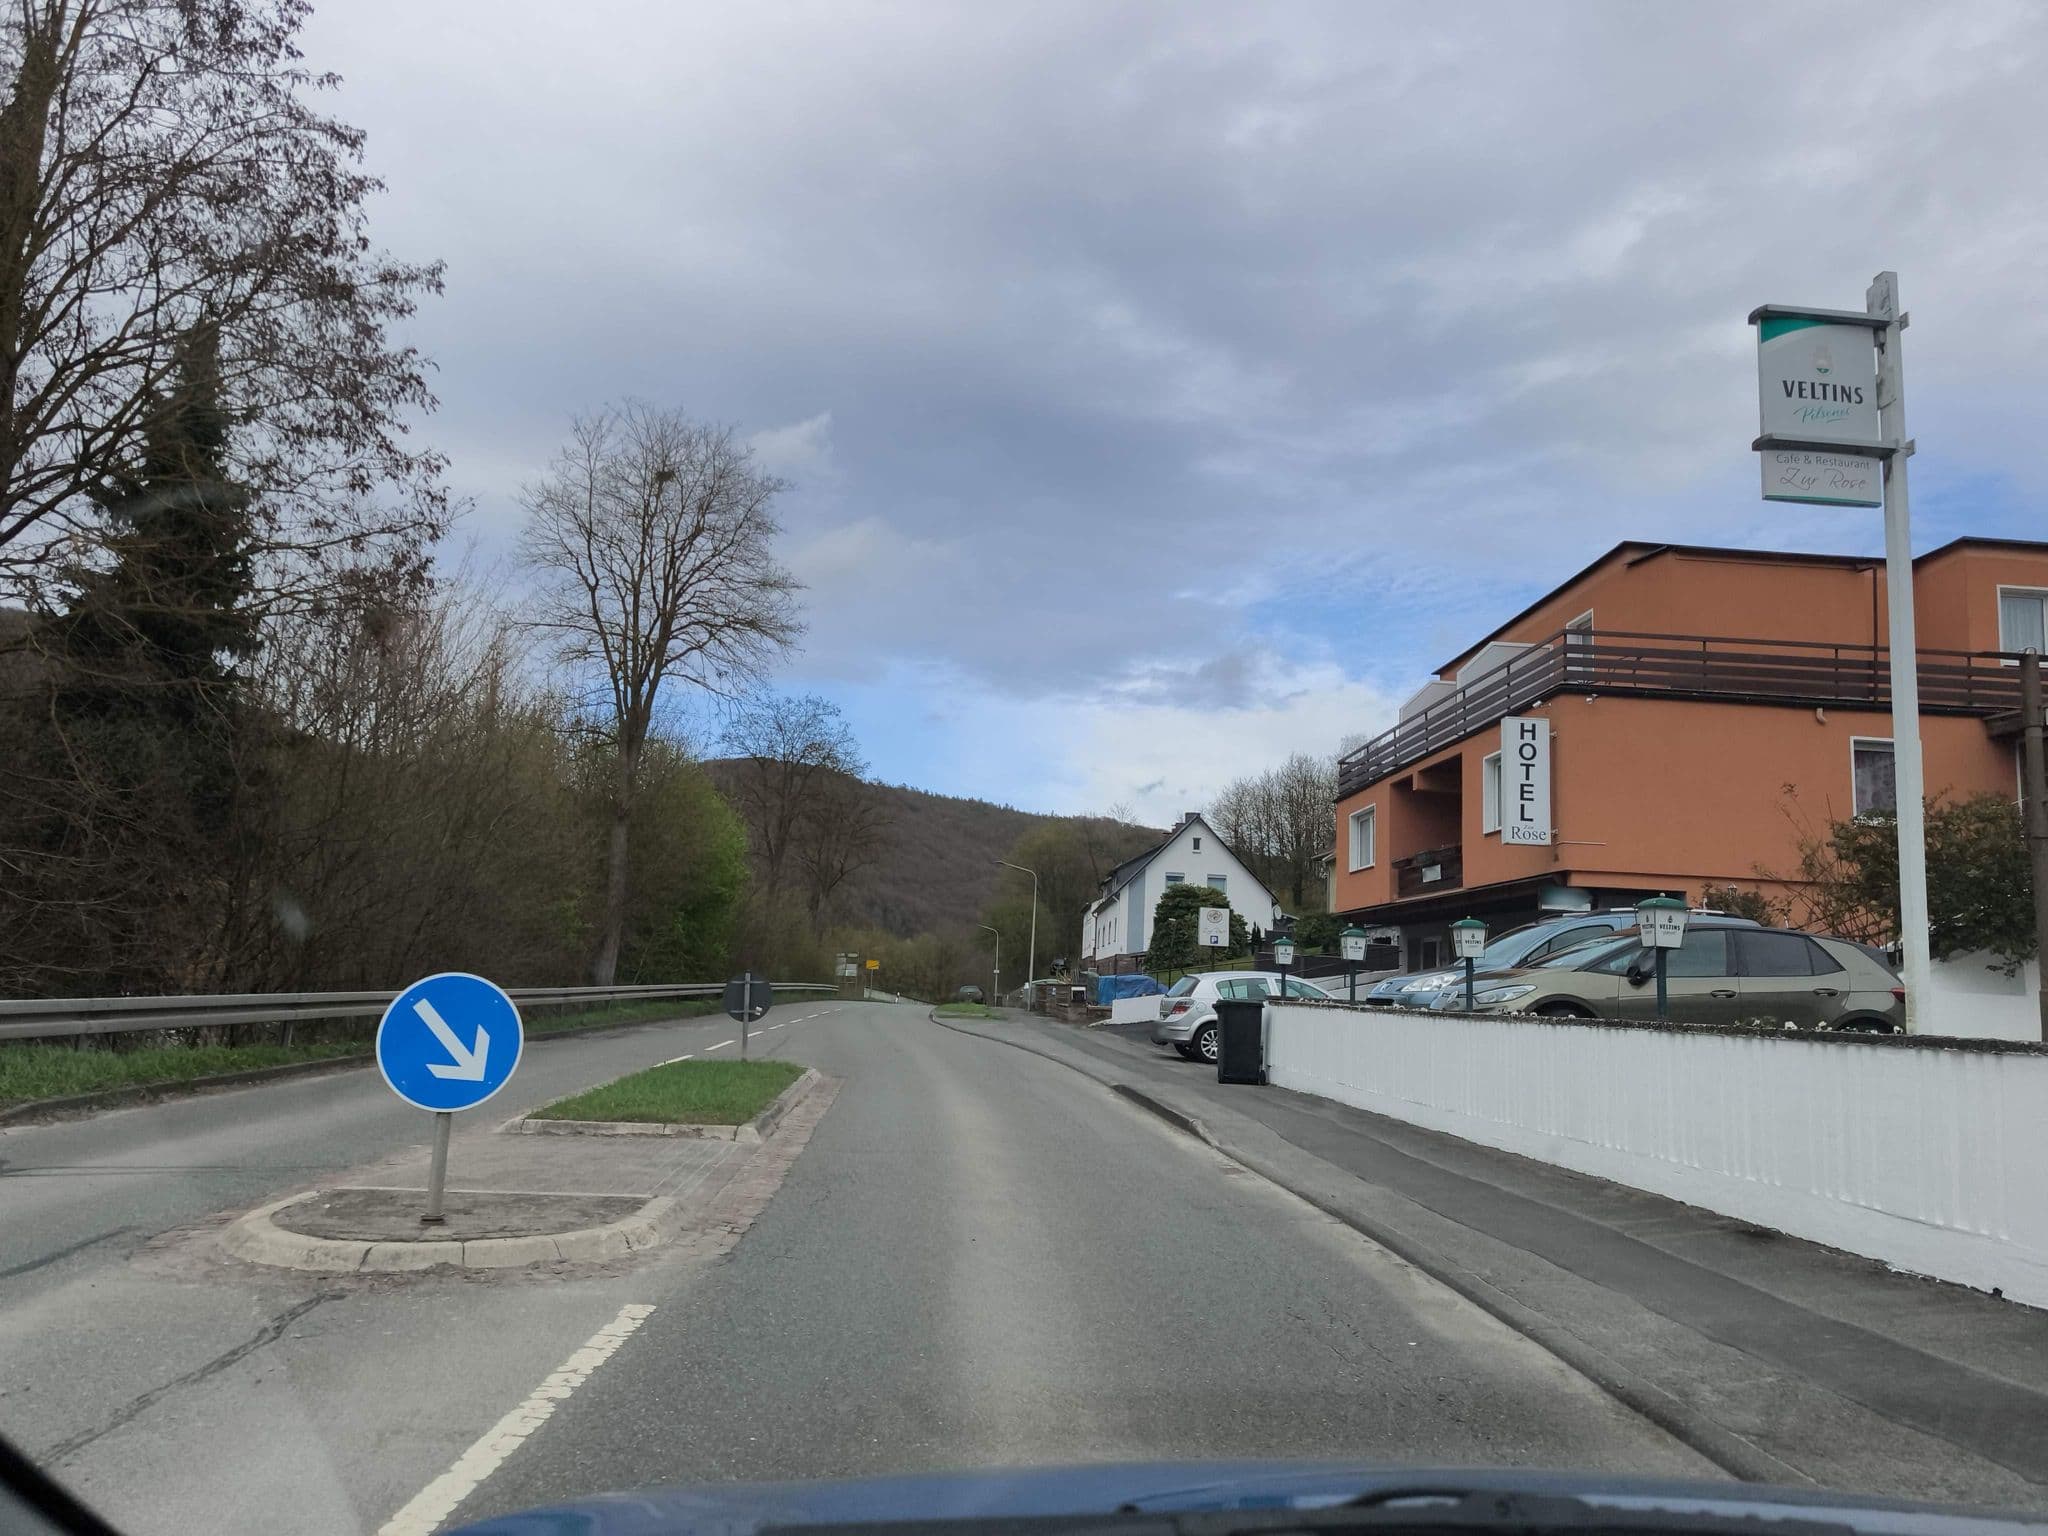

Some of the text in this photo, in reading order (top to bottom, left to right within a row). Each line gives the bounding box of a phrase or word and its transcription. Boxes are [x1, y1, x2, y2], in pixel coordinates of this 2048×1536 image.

[1782, 380, 1863, 405] VELTINS
[1815, 456, 1870, 469] Restaurant
[1823, 468, 1867, 489] Rose
[1519, 722, 1537, 822] HOTEL
[1511, 826, 1547, 840] Rose
